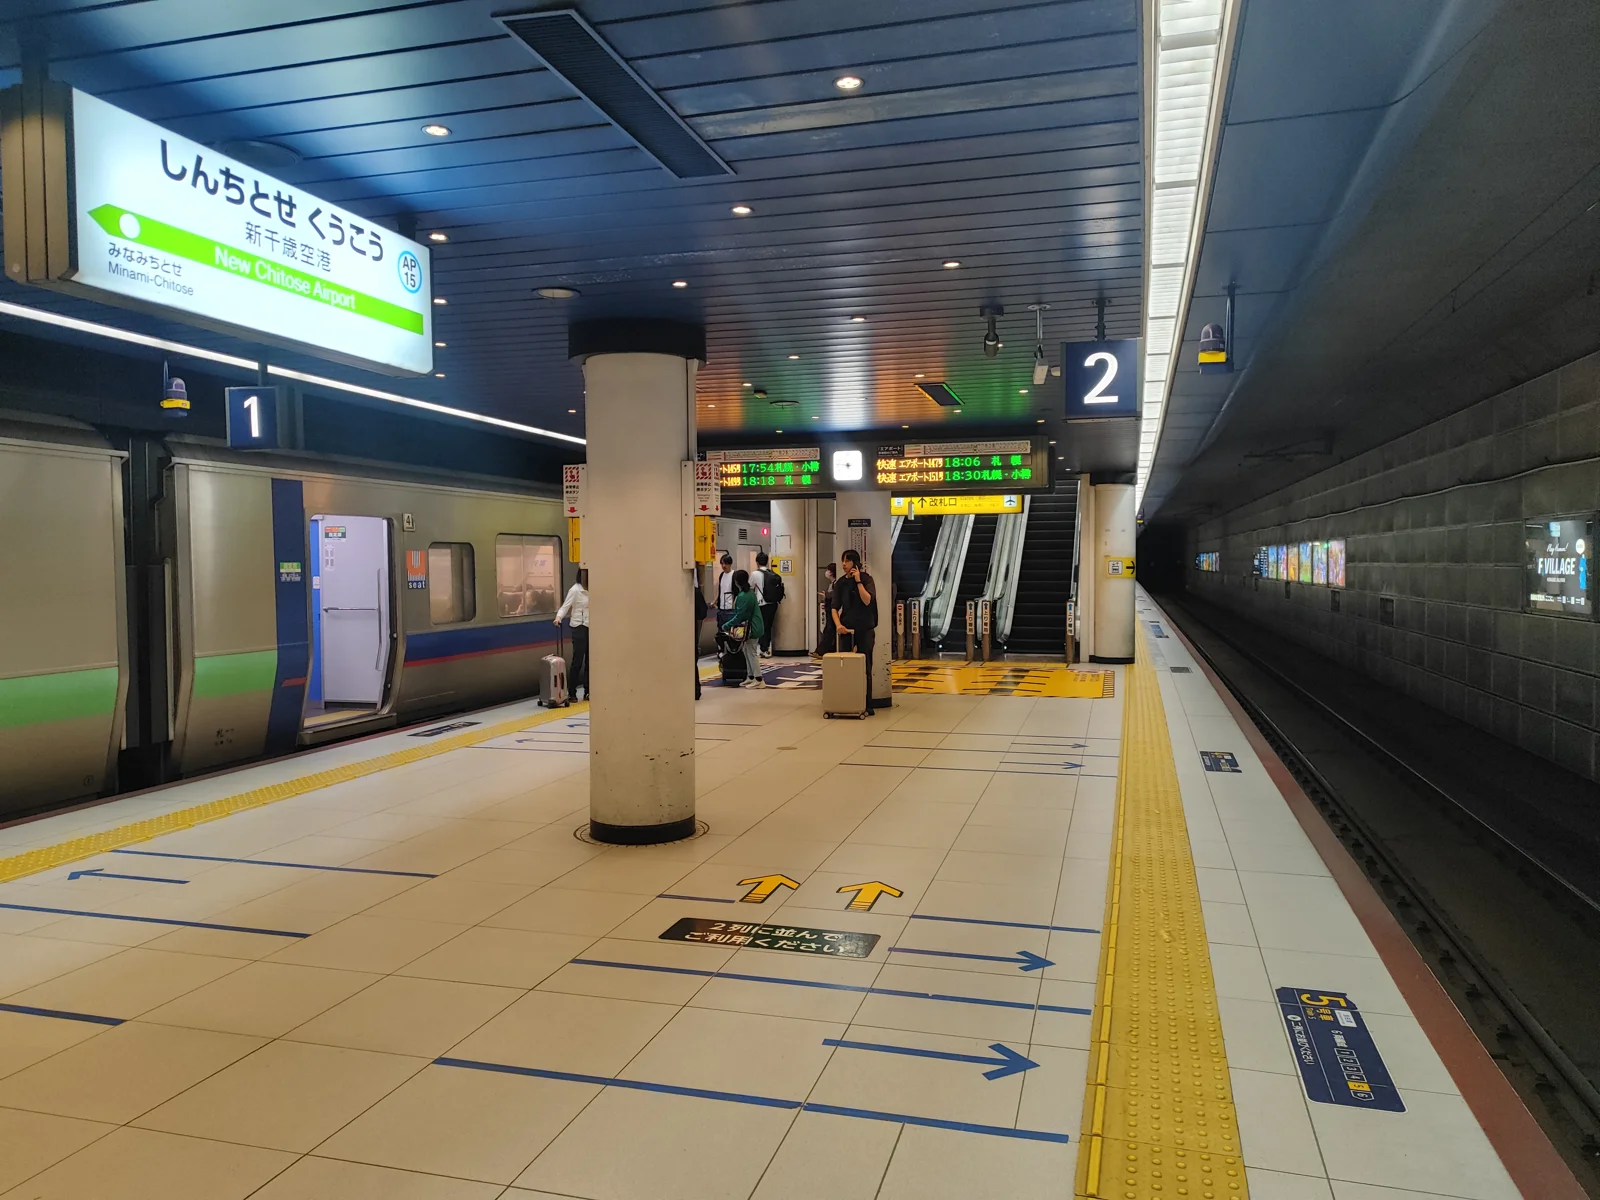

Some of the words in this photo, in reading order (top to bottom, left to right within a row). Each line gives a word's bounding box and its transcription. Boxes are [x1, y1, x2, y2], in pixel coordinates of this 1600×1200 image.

[160, 138, 298, 228] しんちとせ
[307, 206, 386, 263] くうこう
[244, 221, 332, 272] 新千歳空港
[107, 242, 183, 277] みなみちとせ
[401, 257, 418, 273] AP
[108, 260, 194, 297] Minami-Chitose
[213, 244, 253, 273] New
[255, 258, 312, 293] Chitose
[312, 278, 357, 310] Airport
[403, 271, 417, 288] 15
[1083, 351, 1119, 404] 2
[243, 395, 260, 438] 1
[742, 463, 774, 474] 17:54
[877, 458, 897, 470] 快速
[945, 457, 980, 468] 18:06
[742, 476, 775, 486] 18:18
[877, 472, 897, 484] 快速
[945, 470, 980, 481] 18:30
[929, 497, 957, 507] 改札口
[406, 515, 411, 526] 4
[1538, 558, 1544, 575] F
[1544, 557, 1575, 575] VILLAGE
[408, 581, 425, 589] seat
[1300, 993, 1347, 1007] 5
